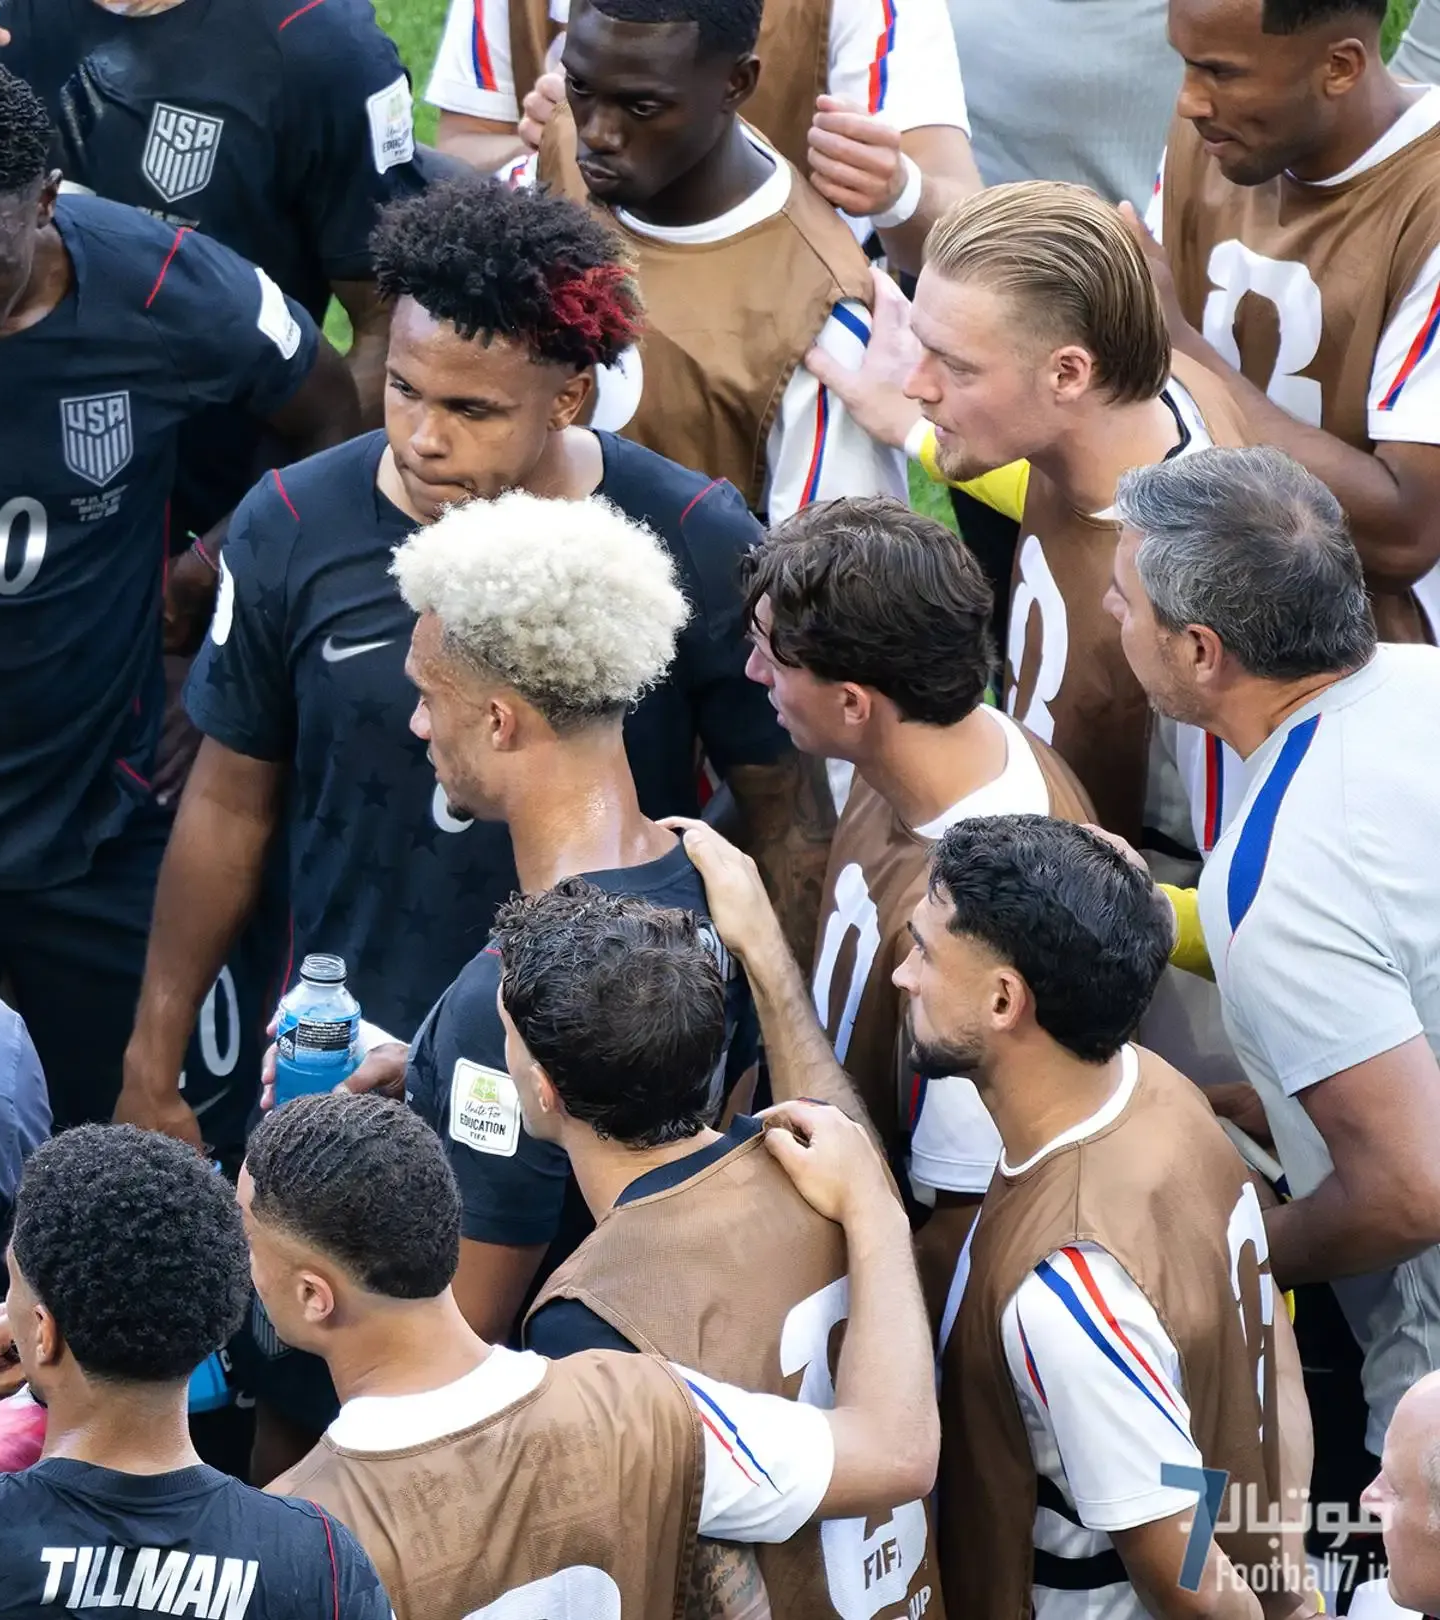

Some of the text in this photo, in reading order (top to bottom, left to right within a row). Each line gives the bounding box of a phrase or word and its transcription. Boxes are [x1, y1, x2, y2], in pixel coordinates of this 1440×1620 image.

[156, 109, 216, 152] USA
[67, 397, 125, 435] USA
[460, 1112, 507, 1136] EDUCATION
[39, 1545, 260, 1620] TILLMAN
